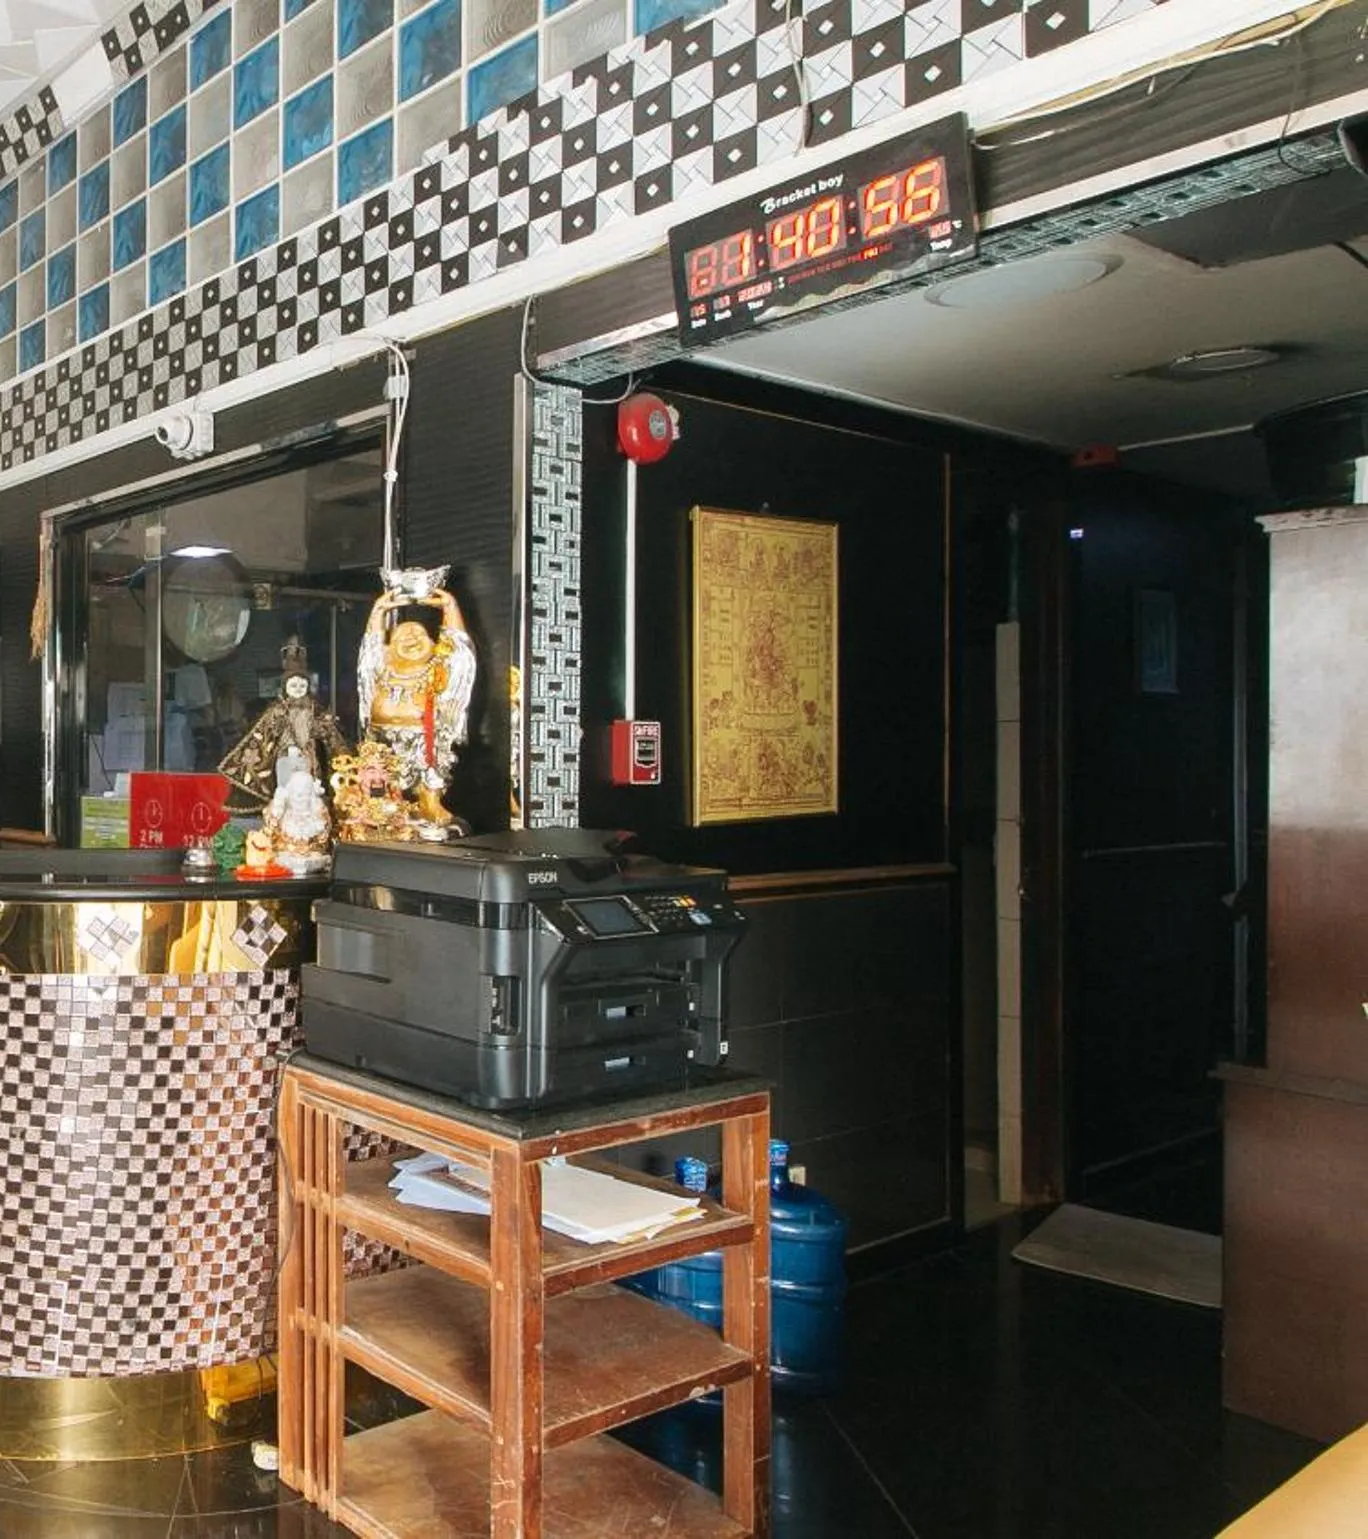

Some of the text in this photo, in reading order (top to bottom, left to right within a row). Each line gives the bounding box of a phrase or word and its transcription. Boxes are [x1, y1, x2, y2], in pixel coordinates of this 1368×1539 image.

[759, 174, 844, 214] Bracket boy
[528, 871, 558, 884] EPSON
